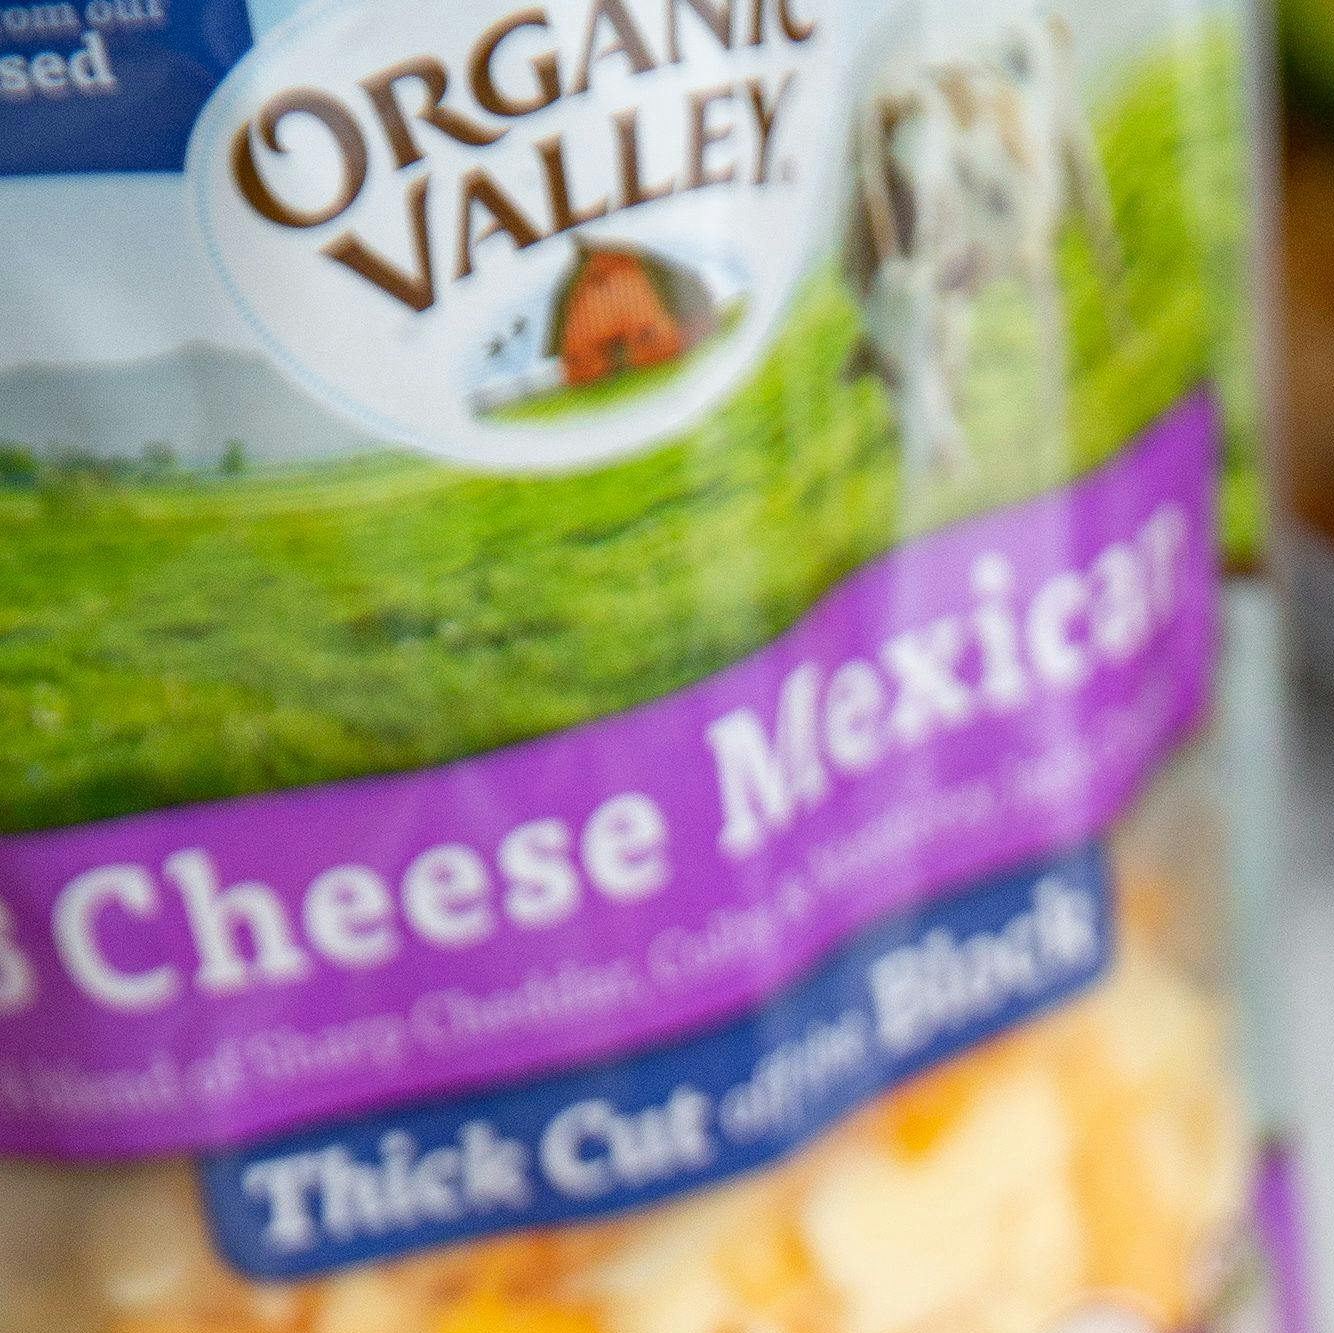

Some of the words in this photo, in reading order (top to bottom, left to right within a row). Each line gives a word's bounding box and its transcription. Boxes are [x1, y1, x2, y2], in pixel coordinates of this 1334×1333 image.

[321, 70, 796, 313] VALLEY
[53, 791, 670, 1012] Cheese
[243, 1120, 530, 1254] Thick
[540, 1084, 712, 1197] Cut
[870, 876, 1096, 1052] Block
